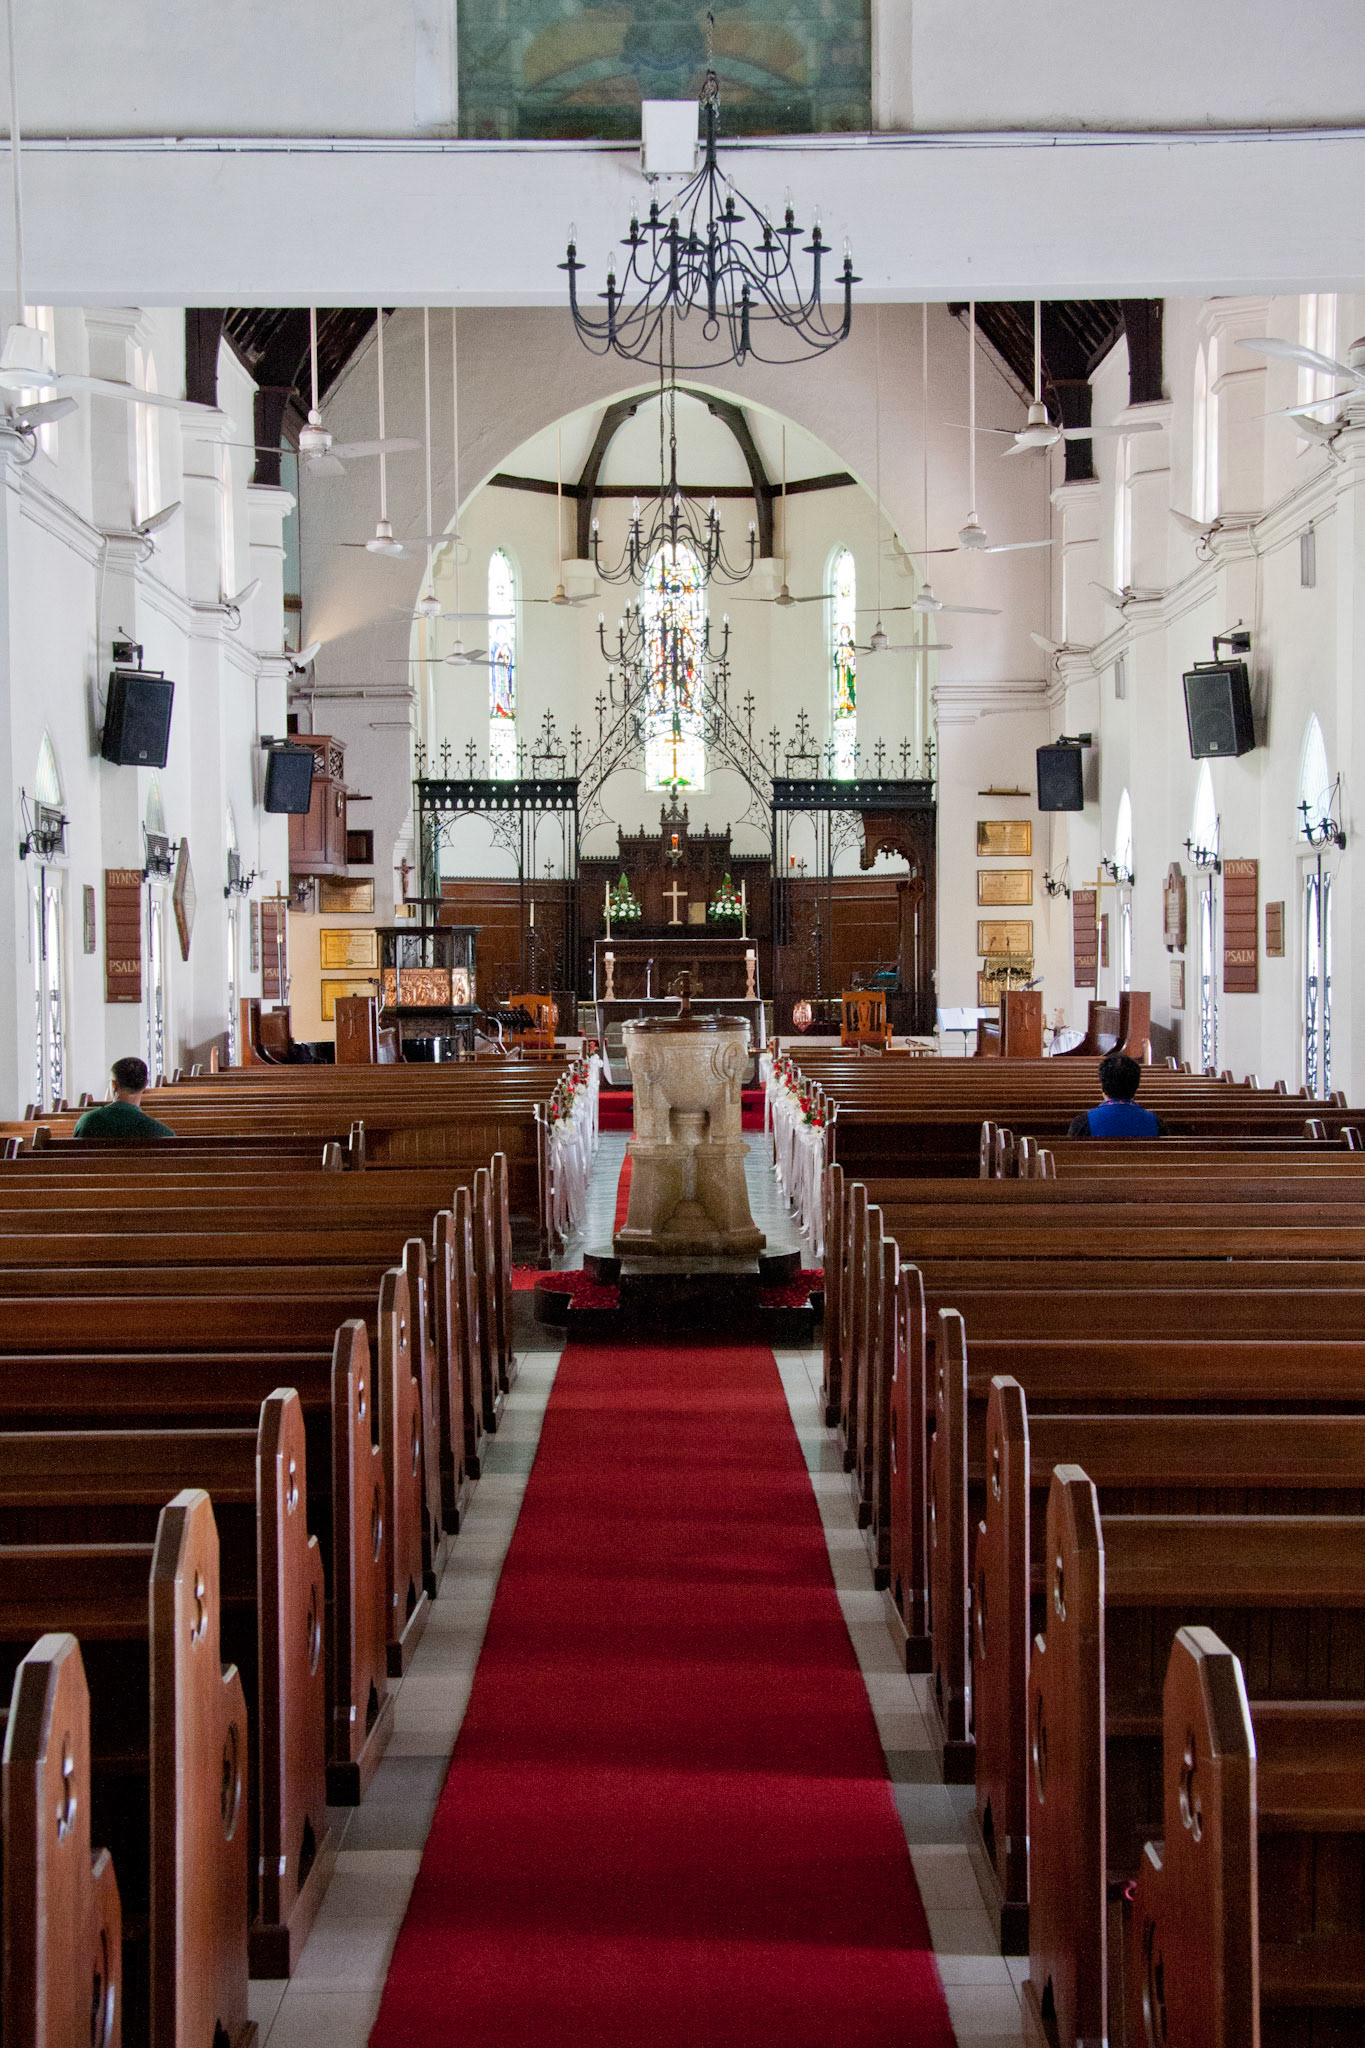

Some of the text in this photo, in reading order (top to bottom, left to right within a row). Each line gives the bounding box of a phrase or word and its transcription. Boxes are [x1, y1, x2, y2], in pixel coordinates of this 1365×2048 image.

[1225, 863, 1254, 874] HYMNS
[109, 872, 139, 884] HYMNS
[263, 903, 285, 913] HYMS
[1225, 951, 1254, 962] PSALM
[109, 960, 139, 972] PSALM
